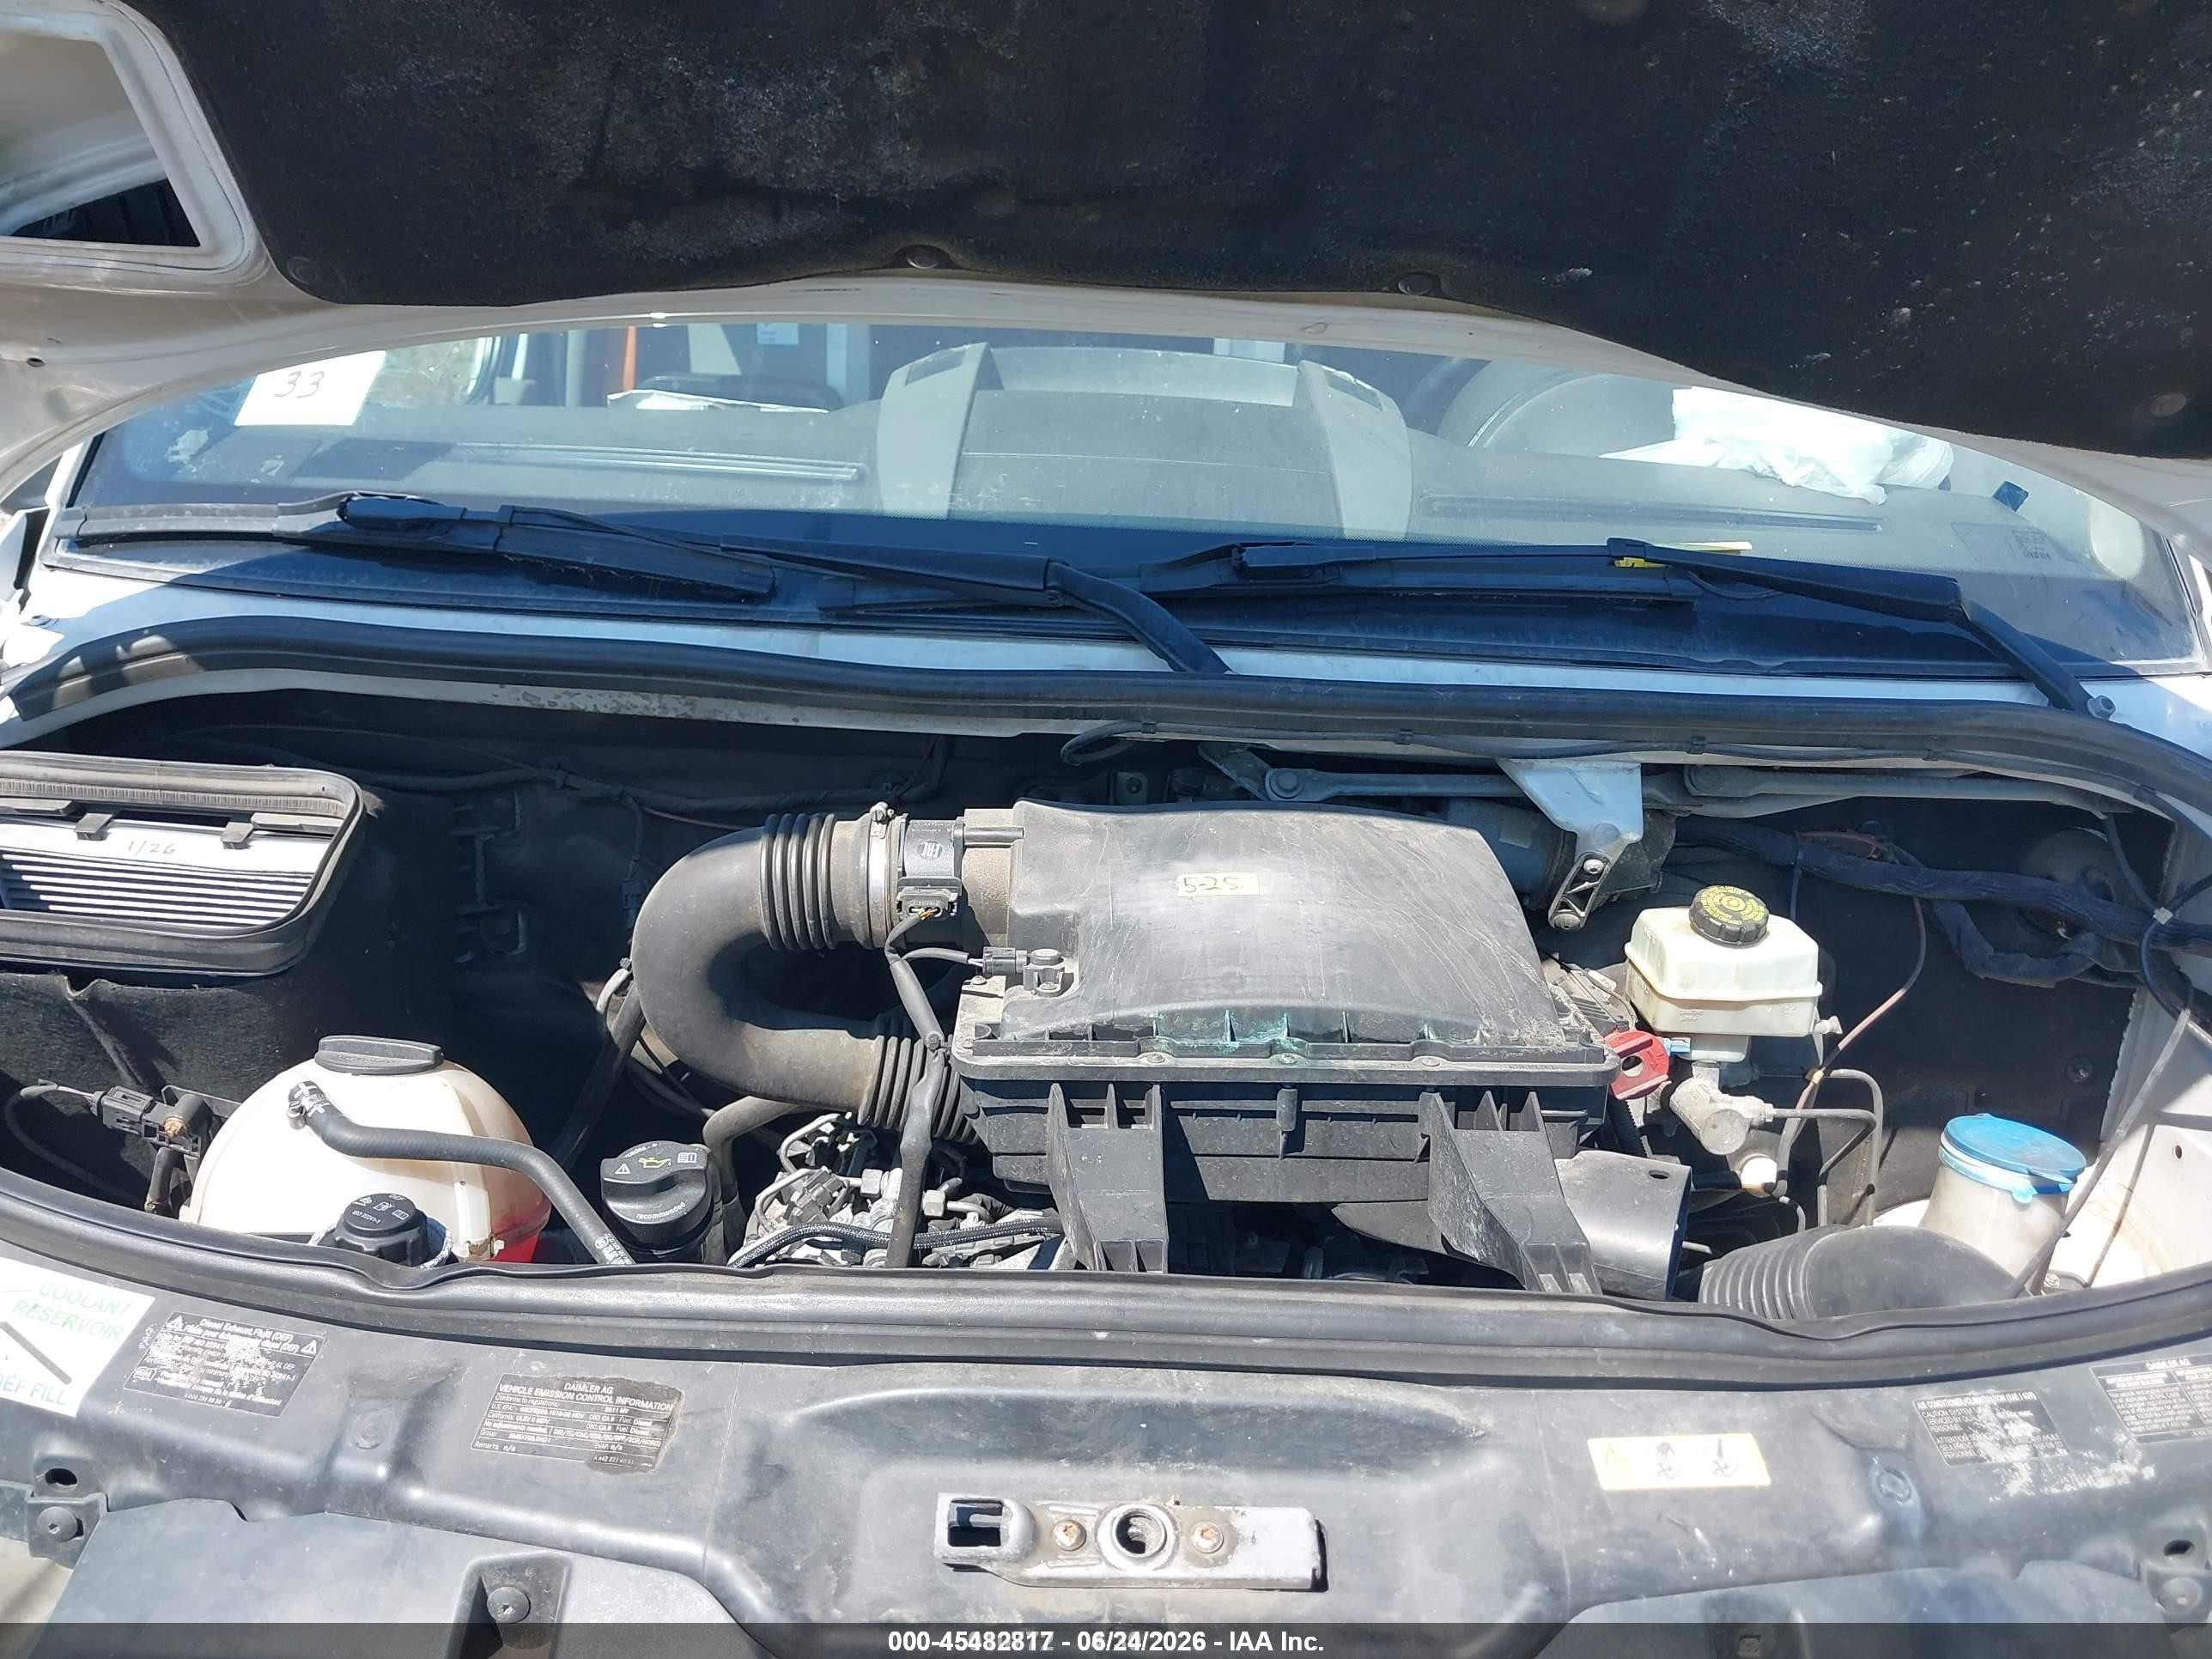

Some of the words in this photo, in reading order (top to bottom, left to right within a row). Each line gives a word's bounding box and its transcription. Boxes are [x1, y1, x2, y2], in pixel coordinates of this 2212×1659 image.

[275, 370, 325, 399] 33
[127, 839, 177, 856] 1/26
[635, 1202, 686, 1220] recommended
[39, 1282, 131, 1316] COOLANT
[12, 1300, 125, 1340] RESERVOIR
[199, 1318, 225, 1329] Diesel
[223, 1322, 254, 1334] Exhaust
[272, 1331, 294, 1343] (DEF)
[280, 1342, 301, 1354] (DEF)
[30, 1382, 67, 1406] FILL
[495, 1394, 522, 1403] Conforms
[499, 1383, 534, 1395] VEHICLE
[533, 1388, 576, 1401] EMISSION
[575, 1393, 614, 1405] CONTROL
[615, 1395, 674, 1411] INFORMATION
[563, 1382, 600, 1394] DAIMLER
[600, 1385, 614, 1395] AG
[629, 1427, 650, 1437] Diesel
